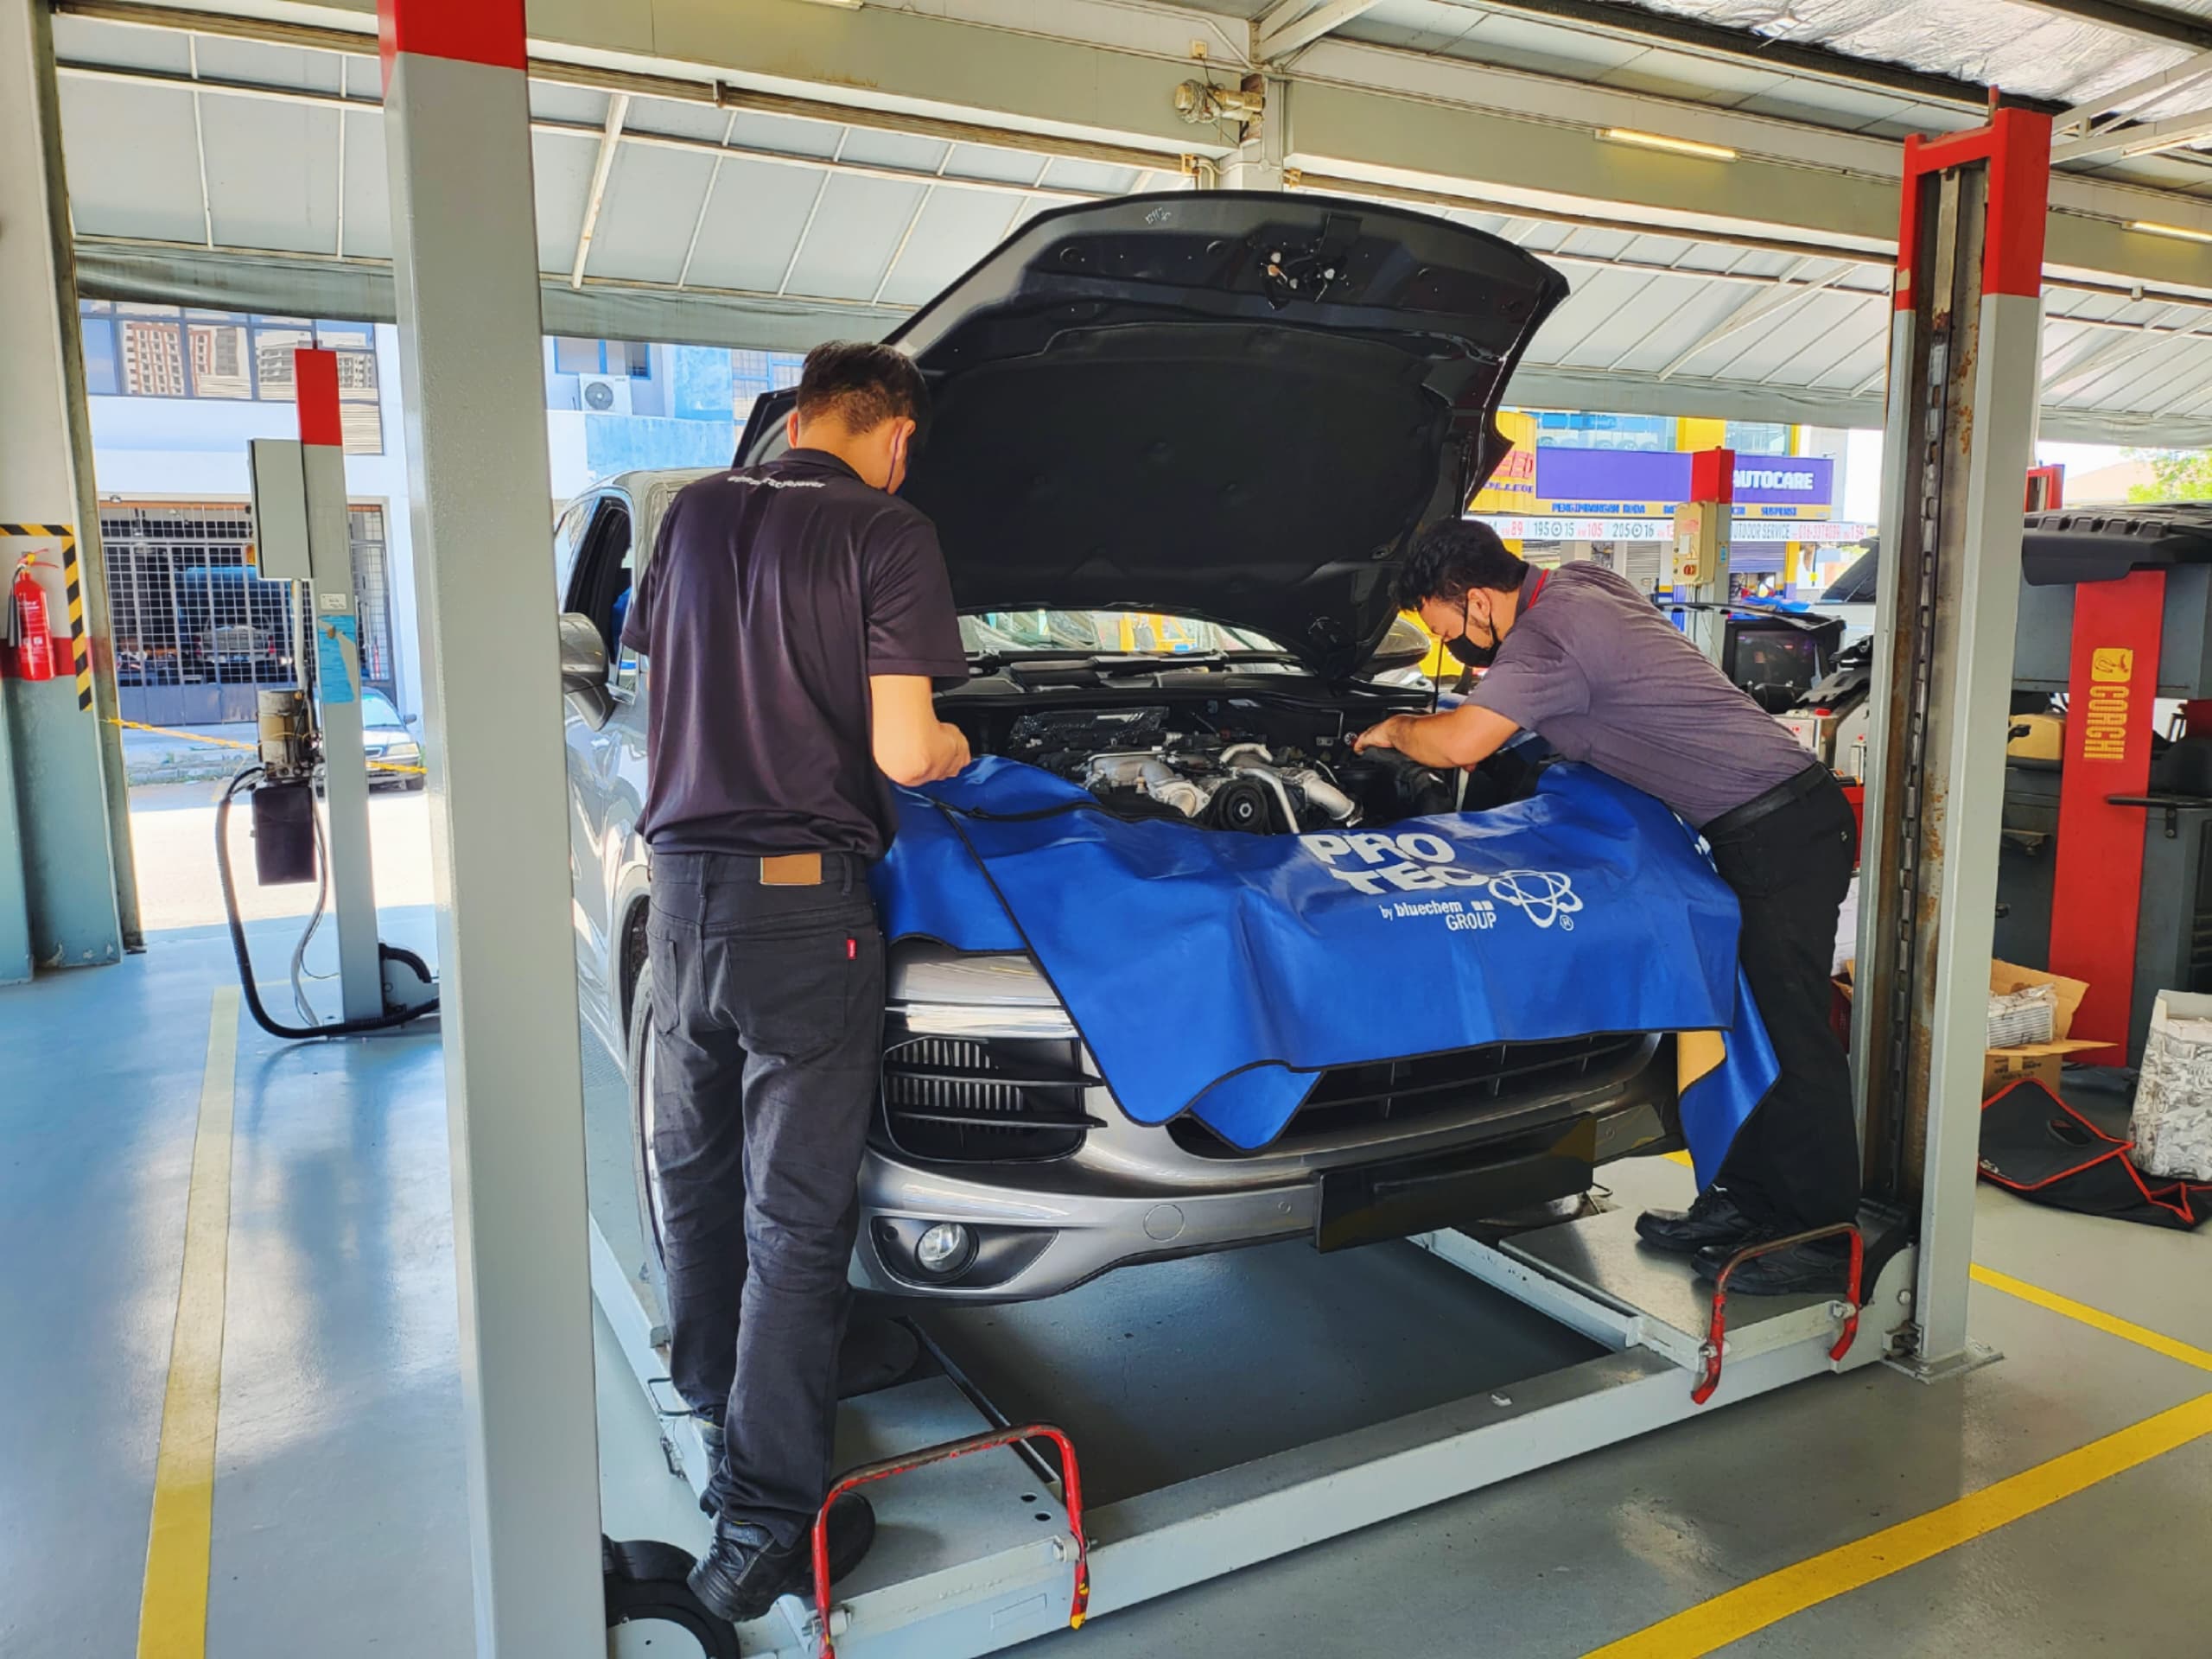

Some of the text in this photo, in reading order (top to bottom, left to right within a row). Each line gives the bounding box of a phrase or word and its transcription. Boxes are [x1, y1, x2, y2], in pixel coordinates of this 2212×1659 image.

[1733, 470, 1814, 490] AUTOCARE
[1298, 833, 1456, 865] PRO
[1328, 861, 1491, 895] TEC
[1379, 900, 1463, 921] by bluechem
[1446, 912, 1497, 931] GROUP
